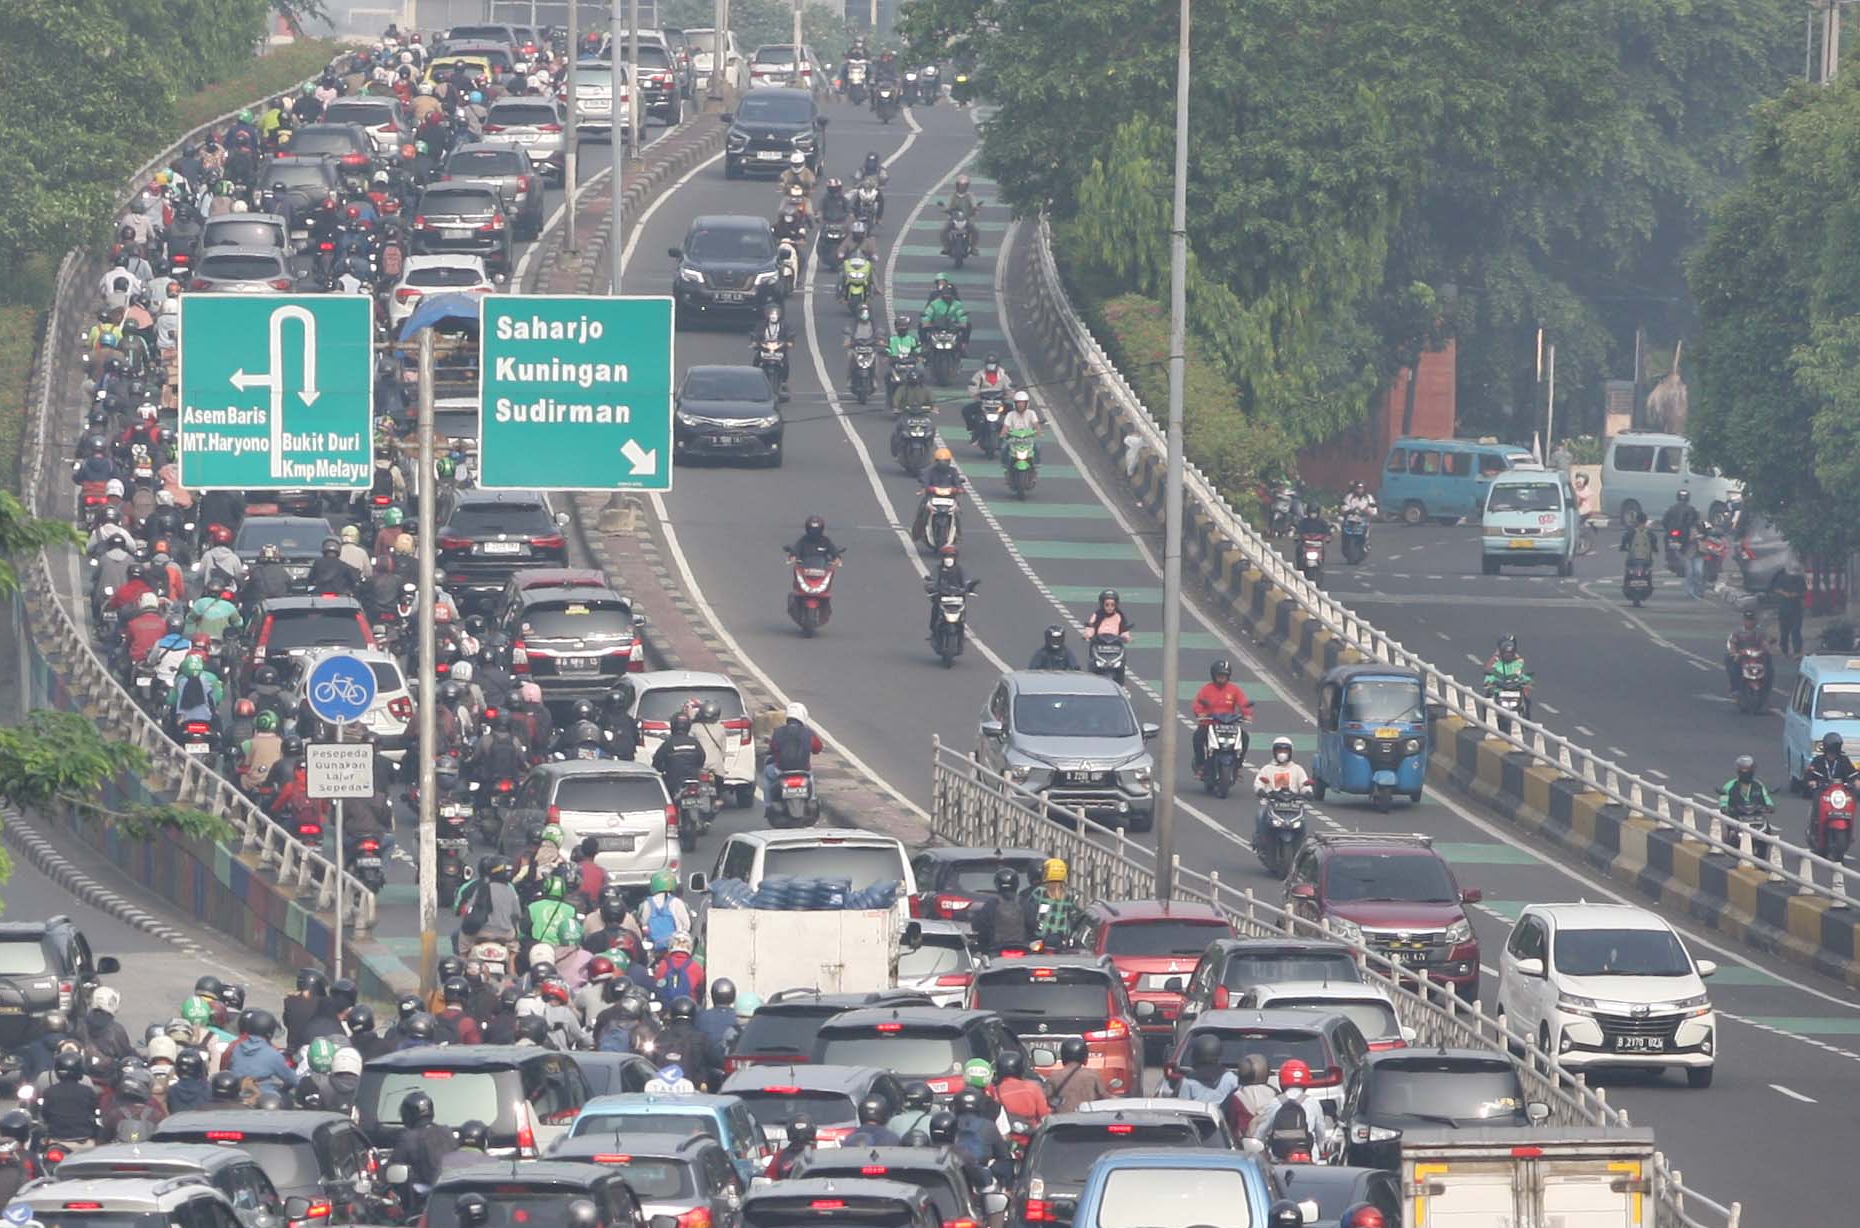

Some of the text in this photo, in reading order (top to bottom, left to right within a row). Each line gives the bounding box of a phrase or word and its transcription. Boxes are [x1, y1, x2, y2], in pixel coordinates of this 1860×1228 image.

[496, 315, 603, 344] Saharjo
[495, 357, 628, 388] Kuningan
[495, 398, 631, 423] Sudirman
[183, 432, 269, 456] MT.Haryono
[283, 432, 360, 451] Bukit Duri
[319, 783, 362, 792] Sepeda
